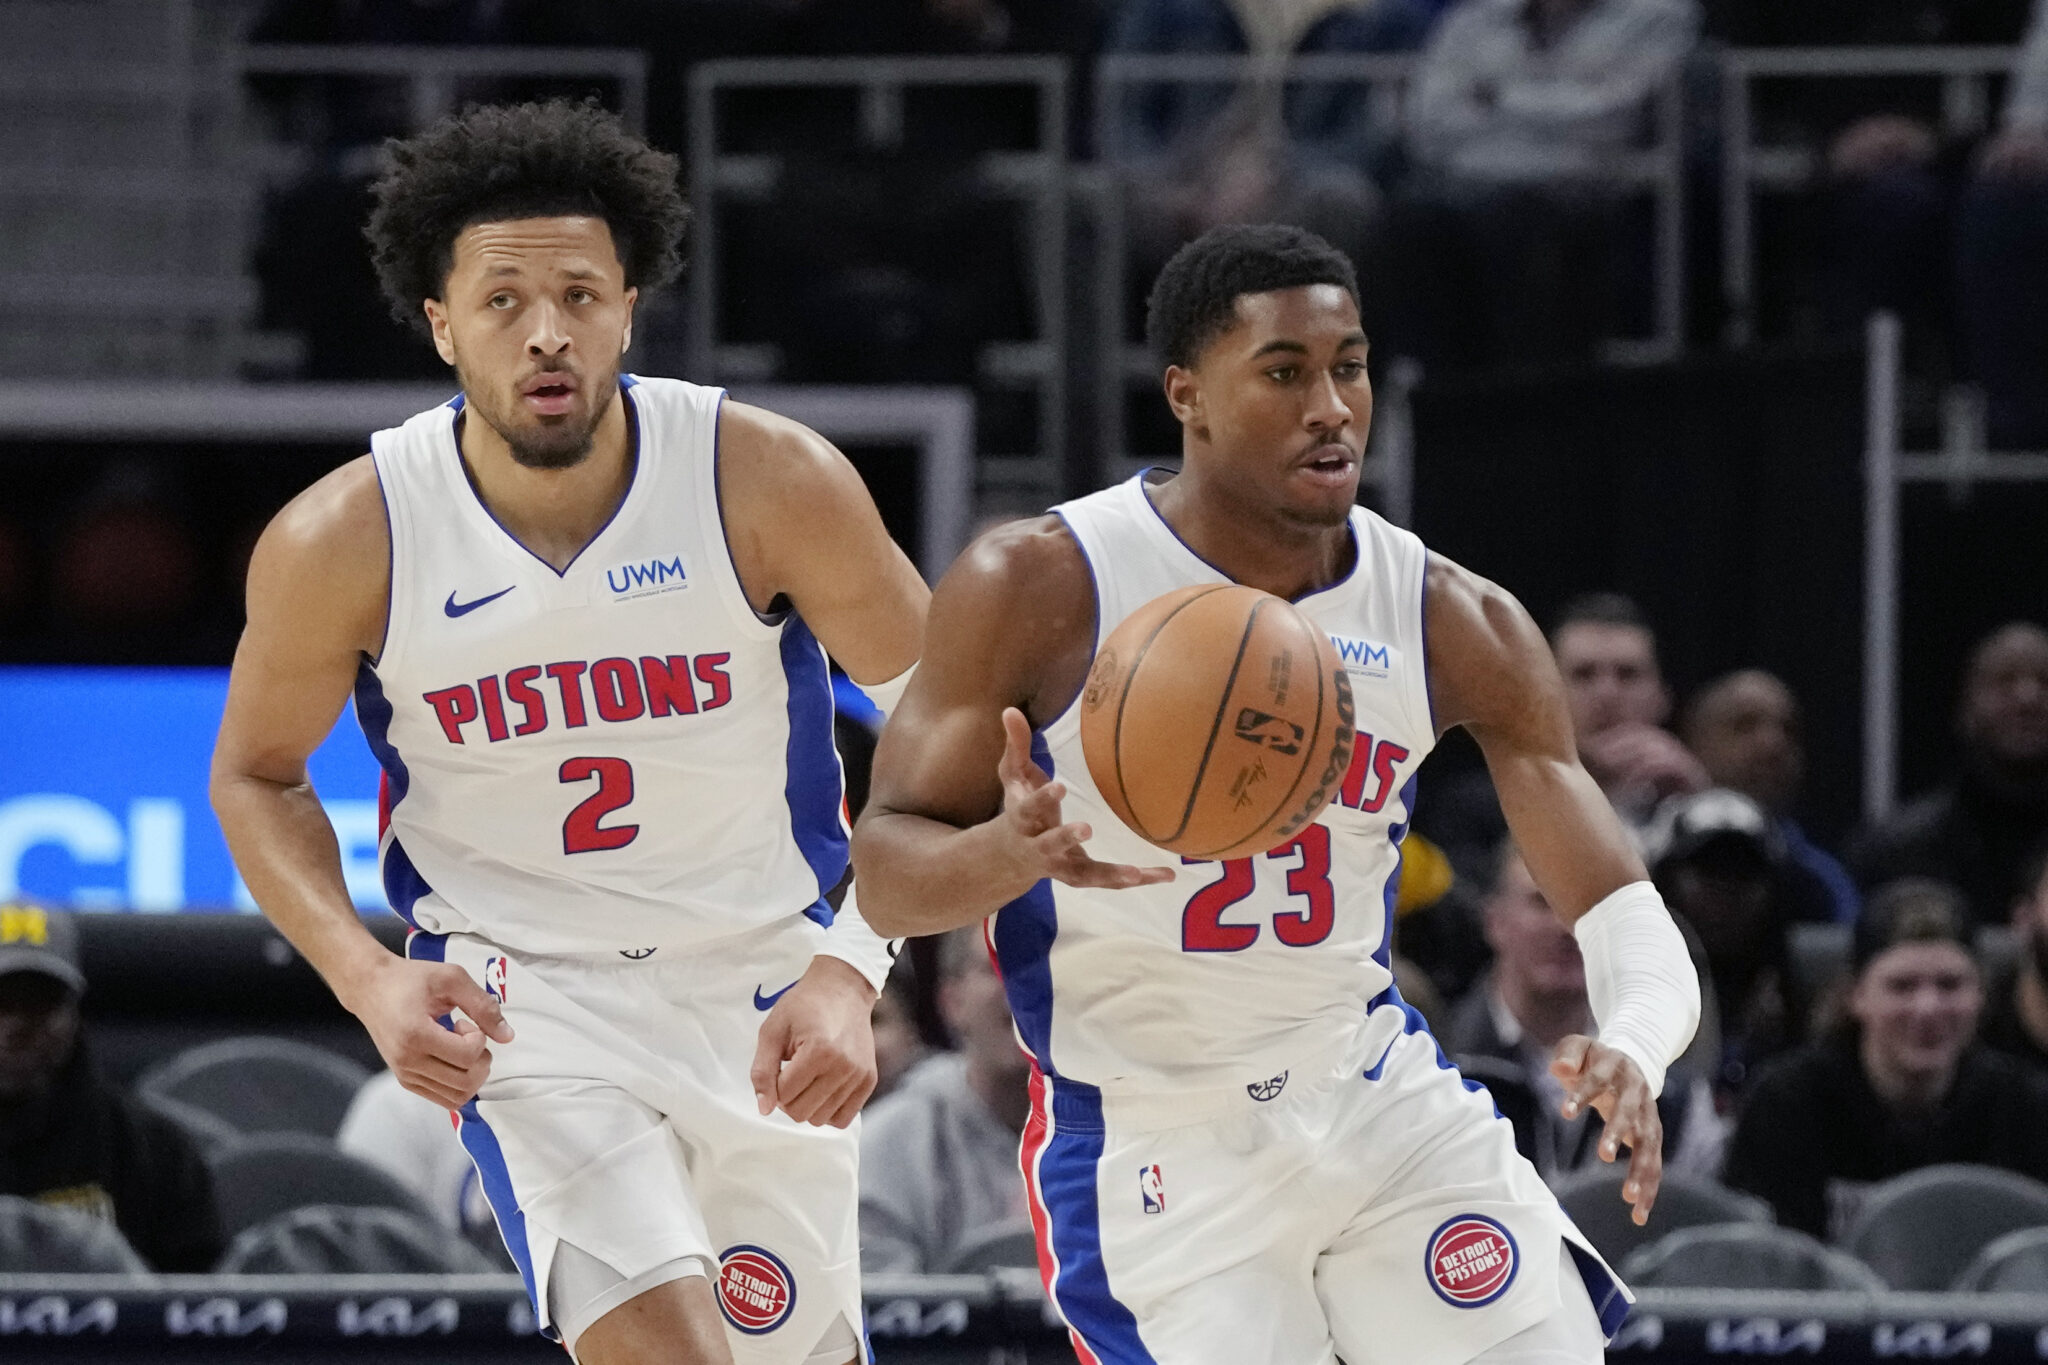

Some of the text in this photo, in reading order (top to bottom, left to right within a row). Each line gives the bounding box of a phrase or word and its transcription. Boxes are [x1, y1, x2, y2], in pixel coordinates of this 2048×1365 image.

[607, 555, 686, 593] UWM
[422, 651, 732, 745] PISTONS
[559, 756, 640, 855] 2
[1181, 822, 1335, 952] 23
[1440, 1236, 1496, 1271] DETROIT
[1445, 1250, 1503, 1286] PISTONS
[726, 1279, 777, 1313] PISTONS
[729, 1266, 779, 1299] DETROIT
